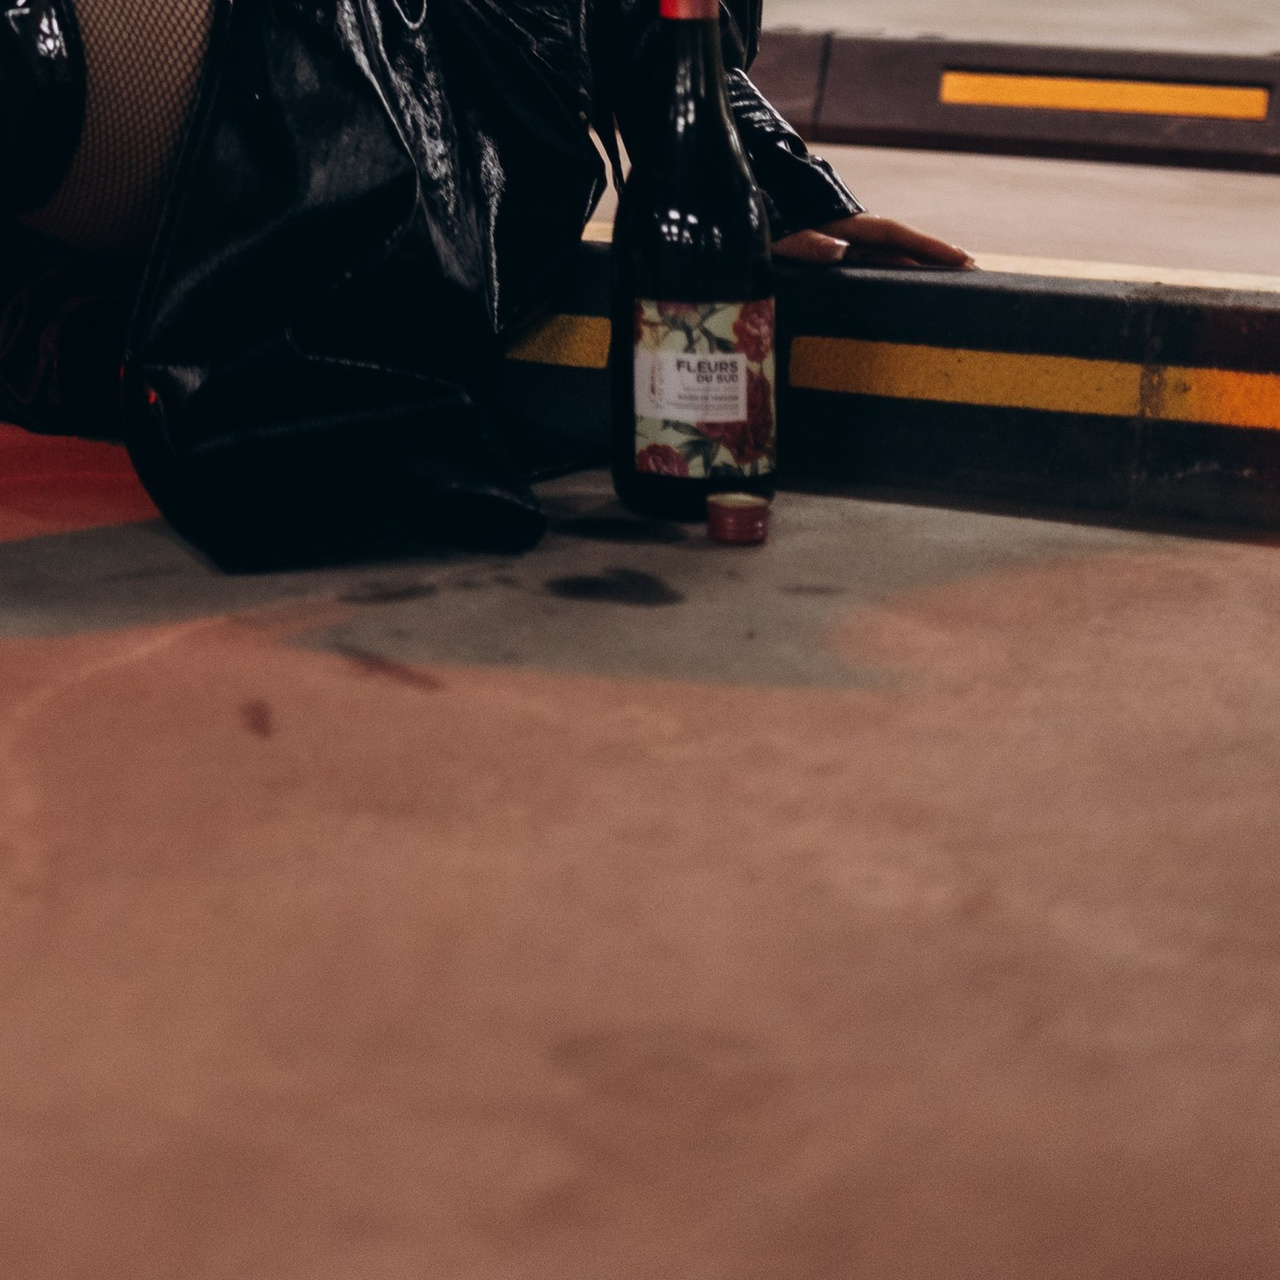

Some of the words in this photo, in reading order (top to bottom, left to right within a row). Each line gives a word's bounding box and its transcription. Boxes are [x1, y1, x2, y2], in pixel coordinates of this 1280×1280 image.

[676, 360, 738, 373] FLEURS
[696, 374, 713, 383] DU
[716, 374, 738, 383] SUD
